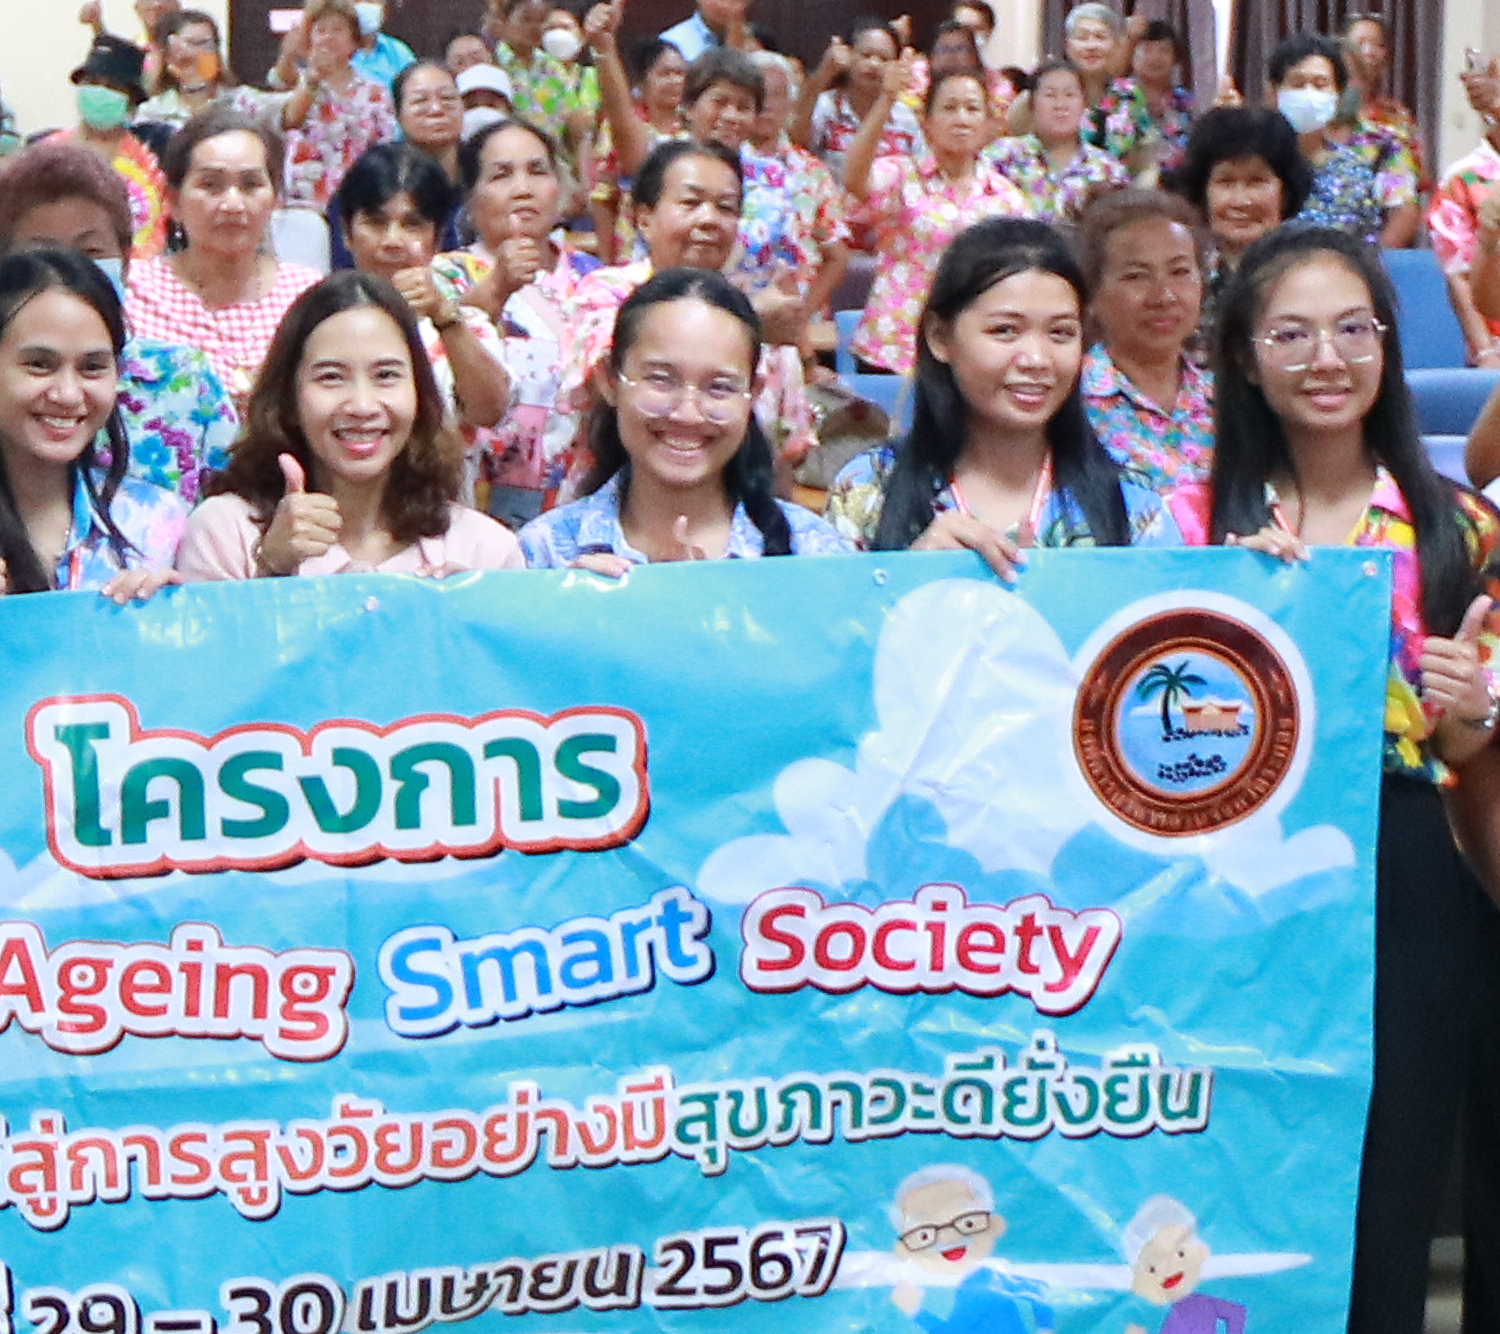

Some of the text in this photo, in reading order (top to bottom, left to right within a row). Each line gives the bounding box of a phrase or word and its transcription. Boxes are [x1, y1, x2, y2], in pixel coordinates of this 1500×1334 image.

[52, 720, 622, 847] โครงการ
[389, 898, 708, 1020] Smart
[755, 899, 1104, 997] Society
[357, 1251, 631, 1333] เมษายน
[653, 1225, 836, 1297] 2567
